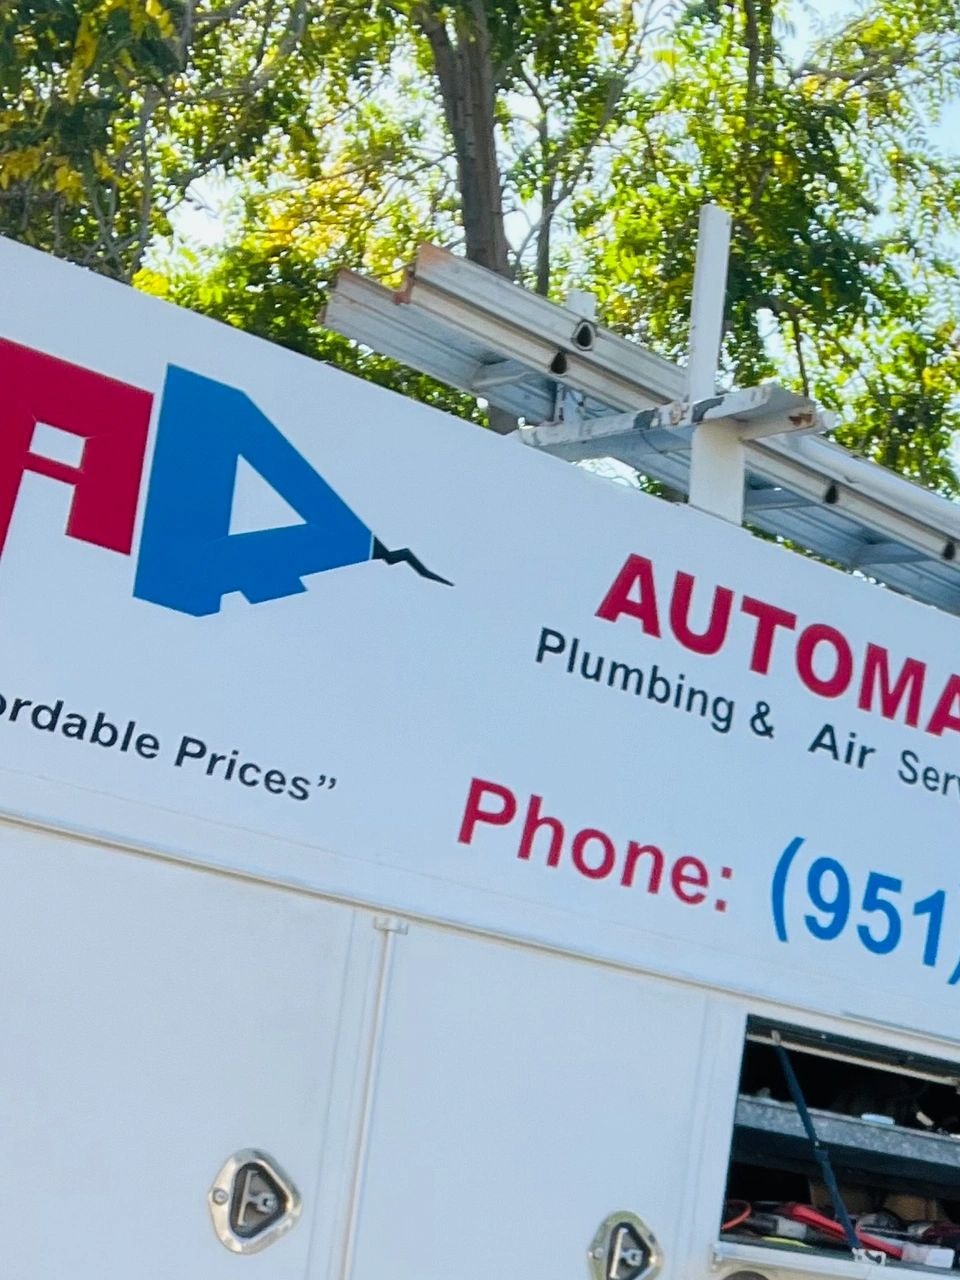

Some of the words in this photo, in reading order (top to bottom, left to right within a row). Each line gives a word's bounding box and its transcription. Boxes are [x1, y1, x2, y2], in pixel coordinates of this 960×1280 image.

[534, 627, 734, 734] Plumbing
[749, 701, 775, 739] &
[807, 723, 876, 769] Air
[457, 777, 733, 913] Phone:
